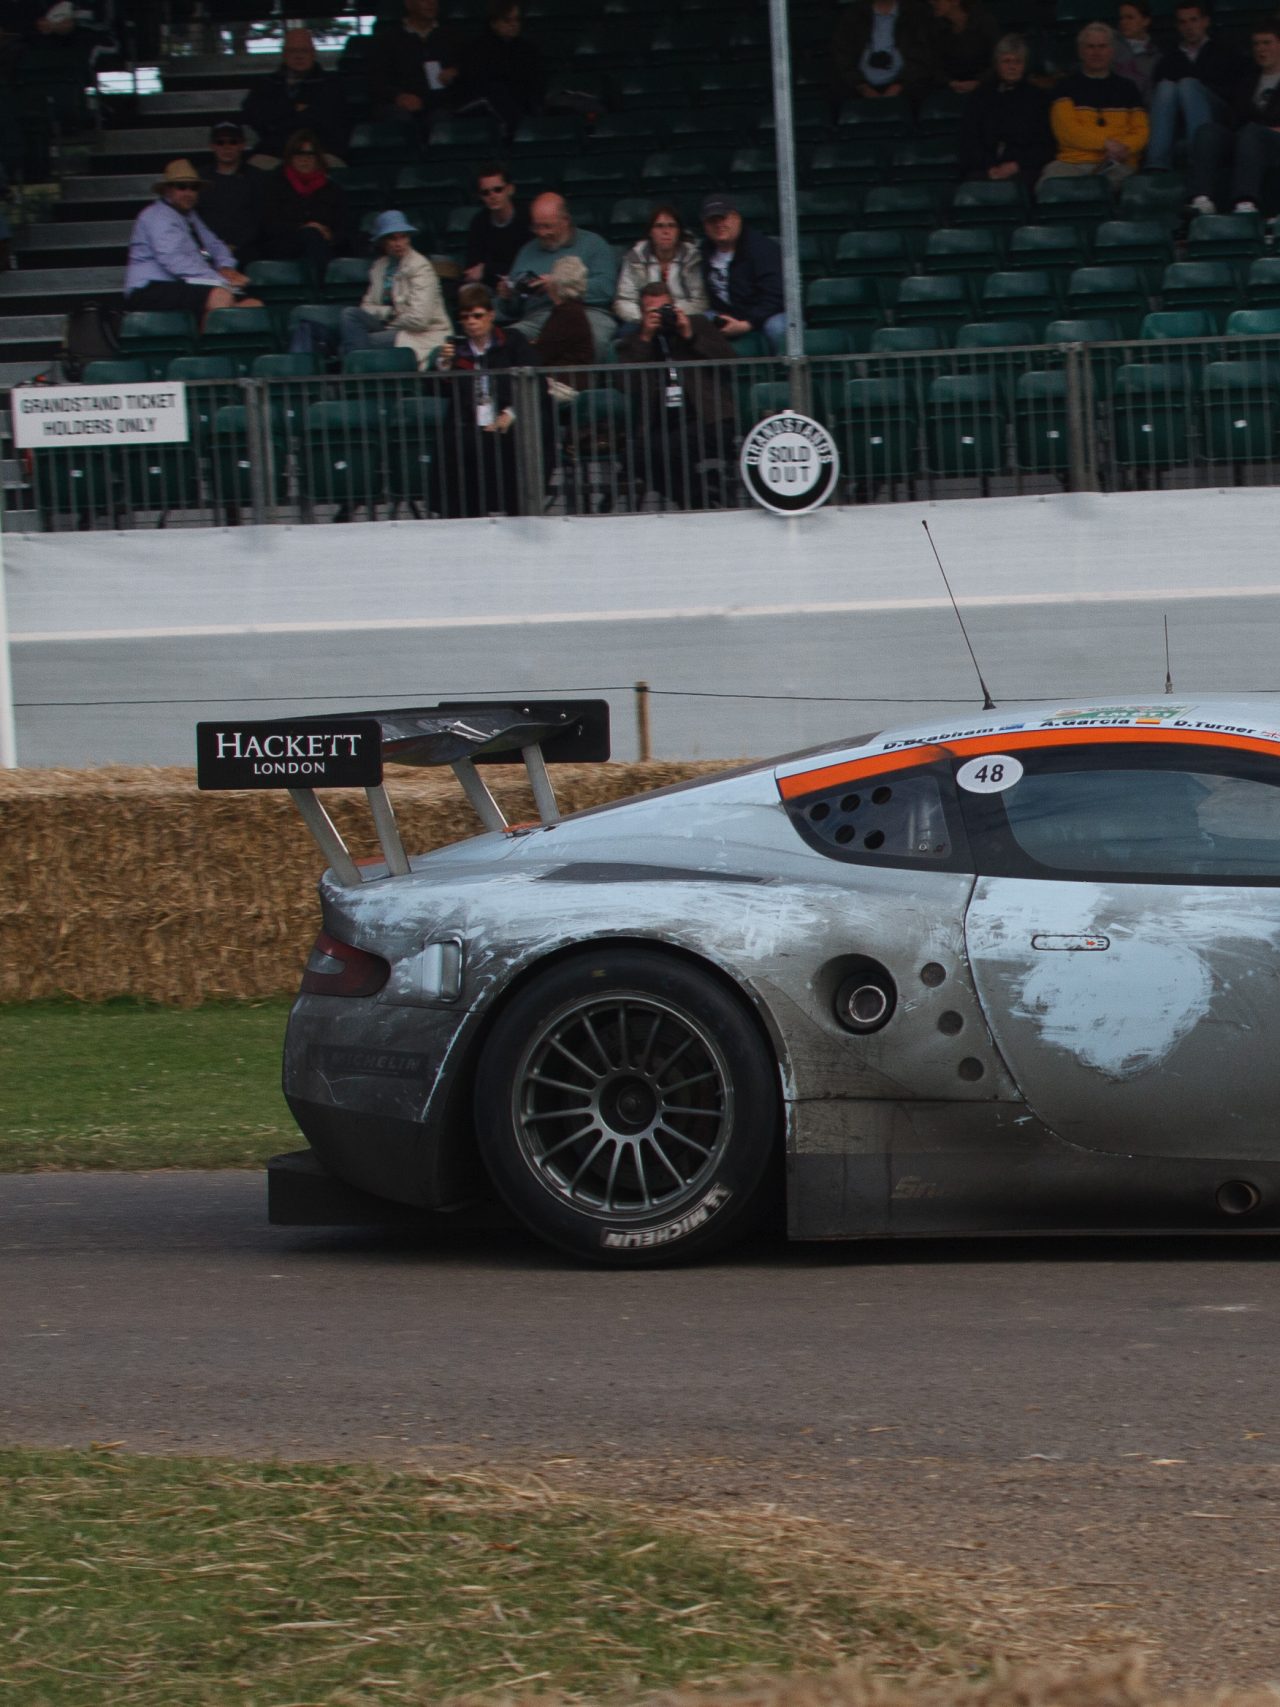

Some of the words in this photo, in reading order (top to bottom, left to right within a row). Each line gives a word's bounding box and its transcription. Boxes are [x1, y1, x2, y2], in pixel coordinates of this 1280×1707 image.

[22, 395, 122, 413] GRANDSTAND
[125, 393, 176, 410] TICKET
[43, 419, 114, 436] HOLDERS
[119, 417, 157, 433] ONLY
[768, 446, 811, 463] SOLD
[768, 466, 811, 483] OUT
[1040, 717, 1130, 727] A.Garcia
[1174, 720, 1256, 734] D.Turner
[216, 733, 362, 758] HACKETT
[254, 762, 325, 774] LONDON
[975, 764, 1004, 783] 48
